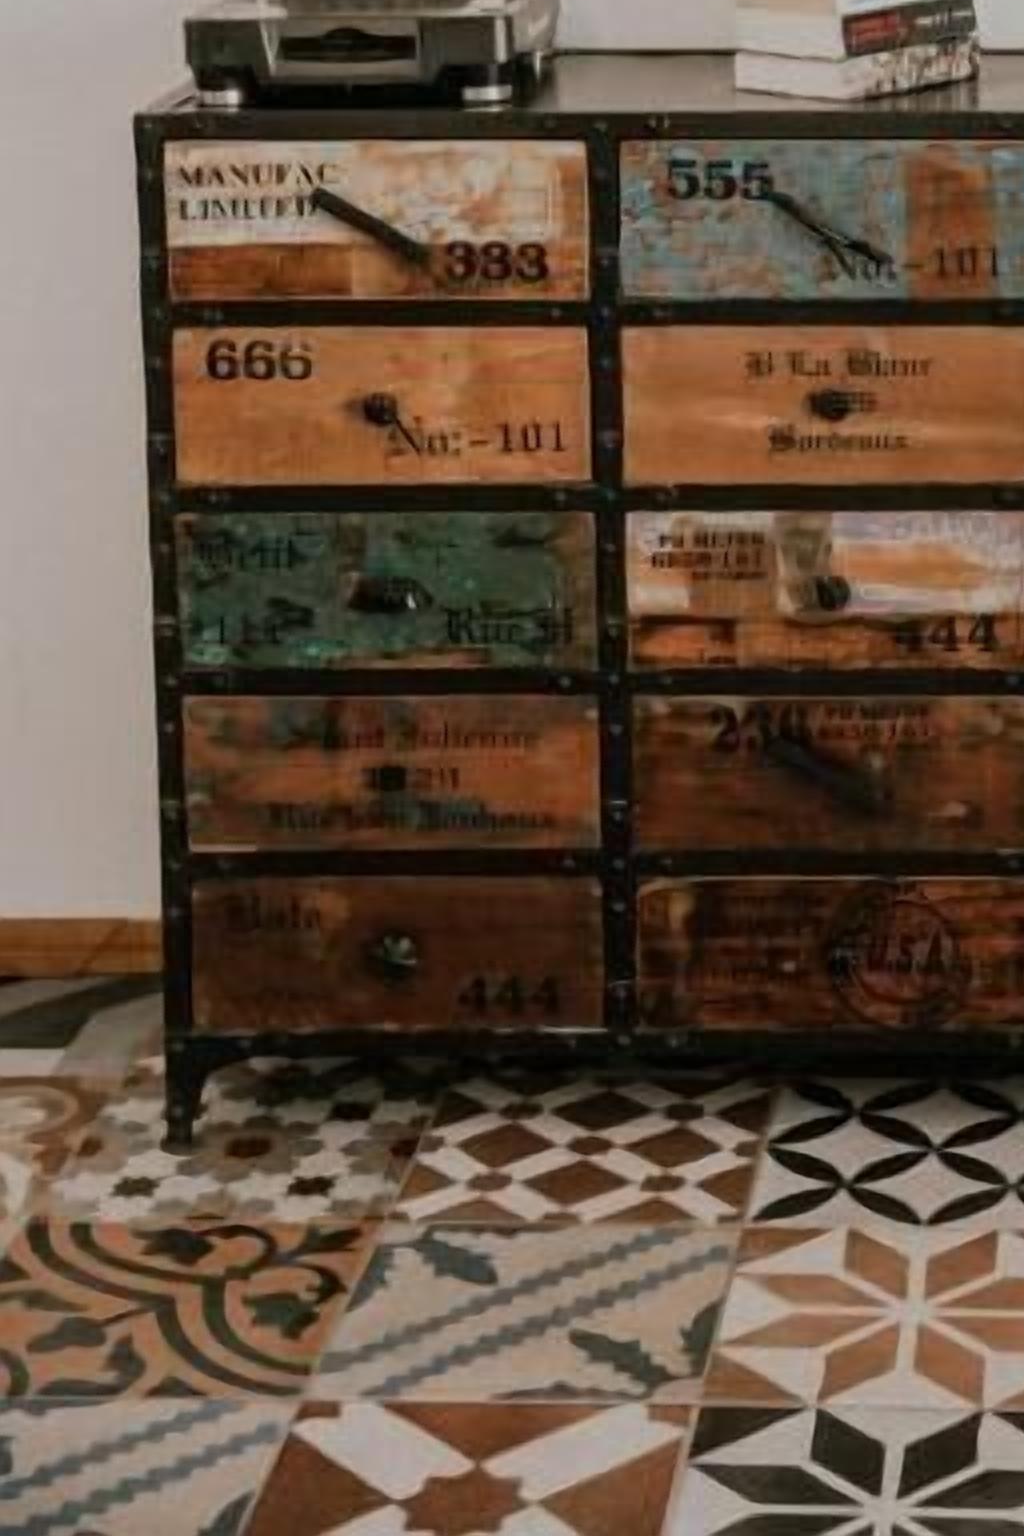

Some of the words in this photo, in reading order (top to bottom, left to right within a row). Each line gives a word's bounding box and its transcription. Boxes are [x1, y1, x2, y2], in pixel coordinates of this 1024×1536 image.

[666, 158, 775, 201] 555
[446, 240, 550, 282] 333
[206, 339, 314, 381] 666
